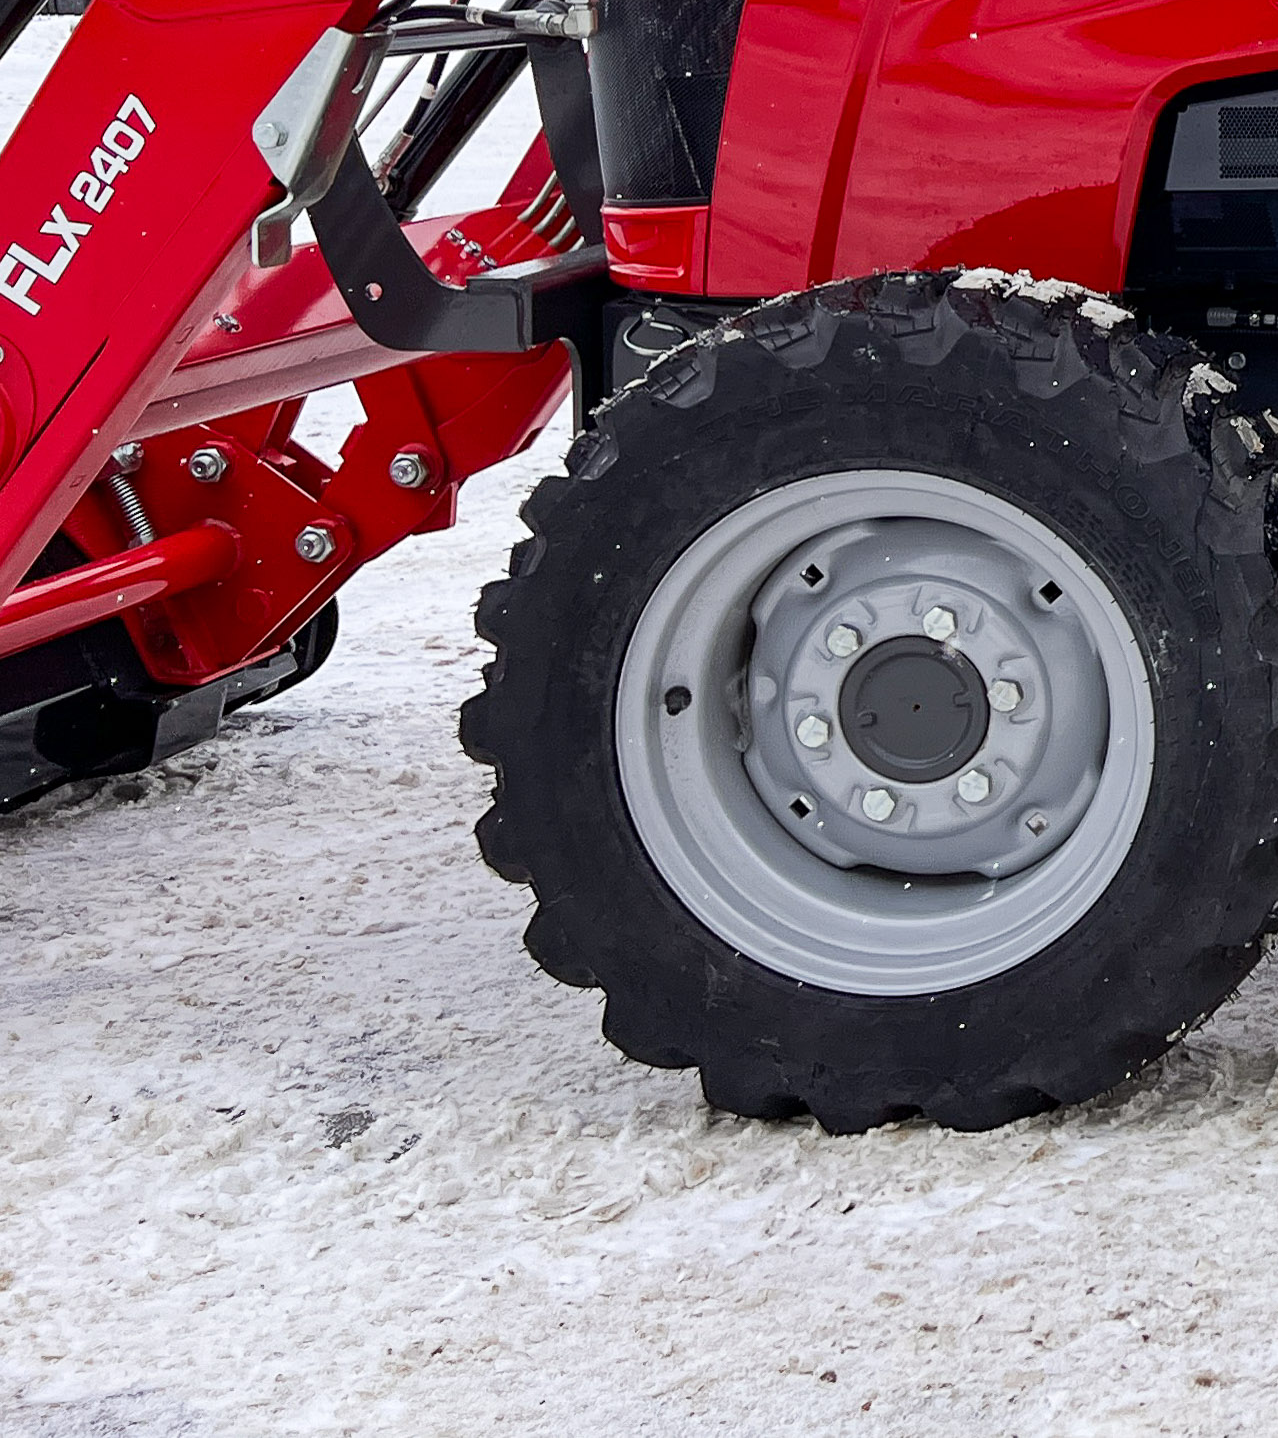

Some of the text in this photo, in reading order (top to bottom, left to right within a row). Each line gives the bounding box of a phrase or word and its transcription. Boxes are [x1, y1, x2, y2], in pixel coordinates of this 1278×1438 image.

[0, 93, 156, 317] FLX 2407
[840, 378, 1222, 636] MARATHONER
